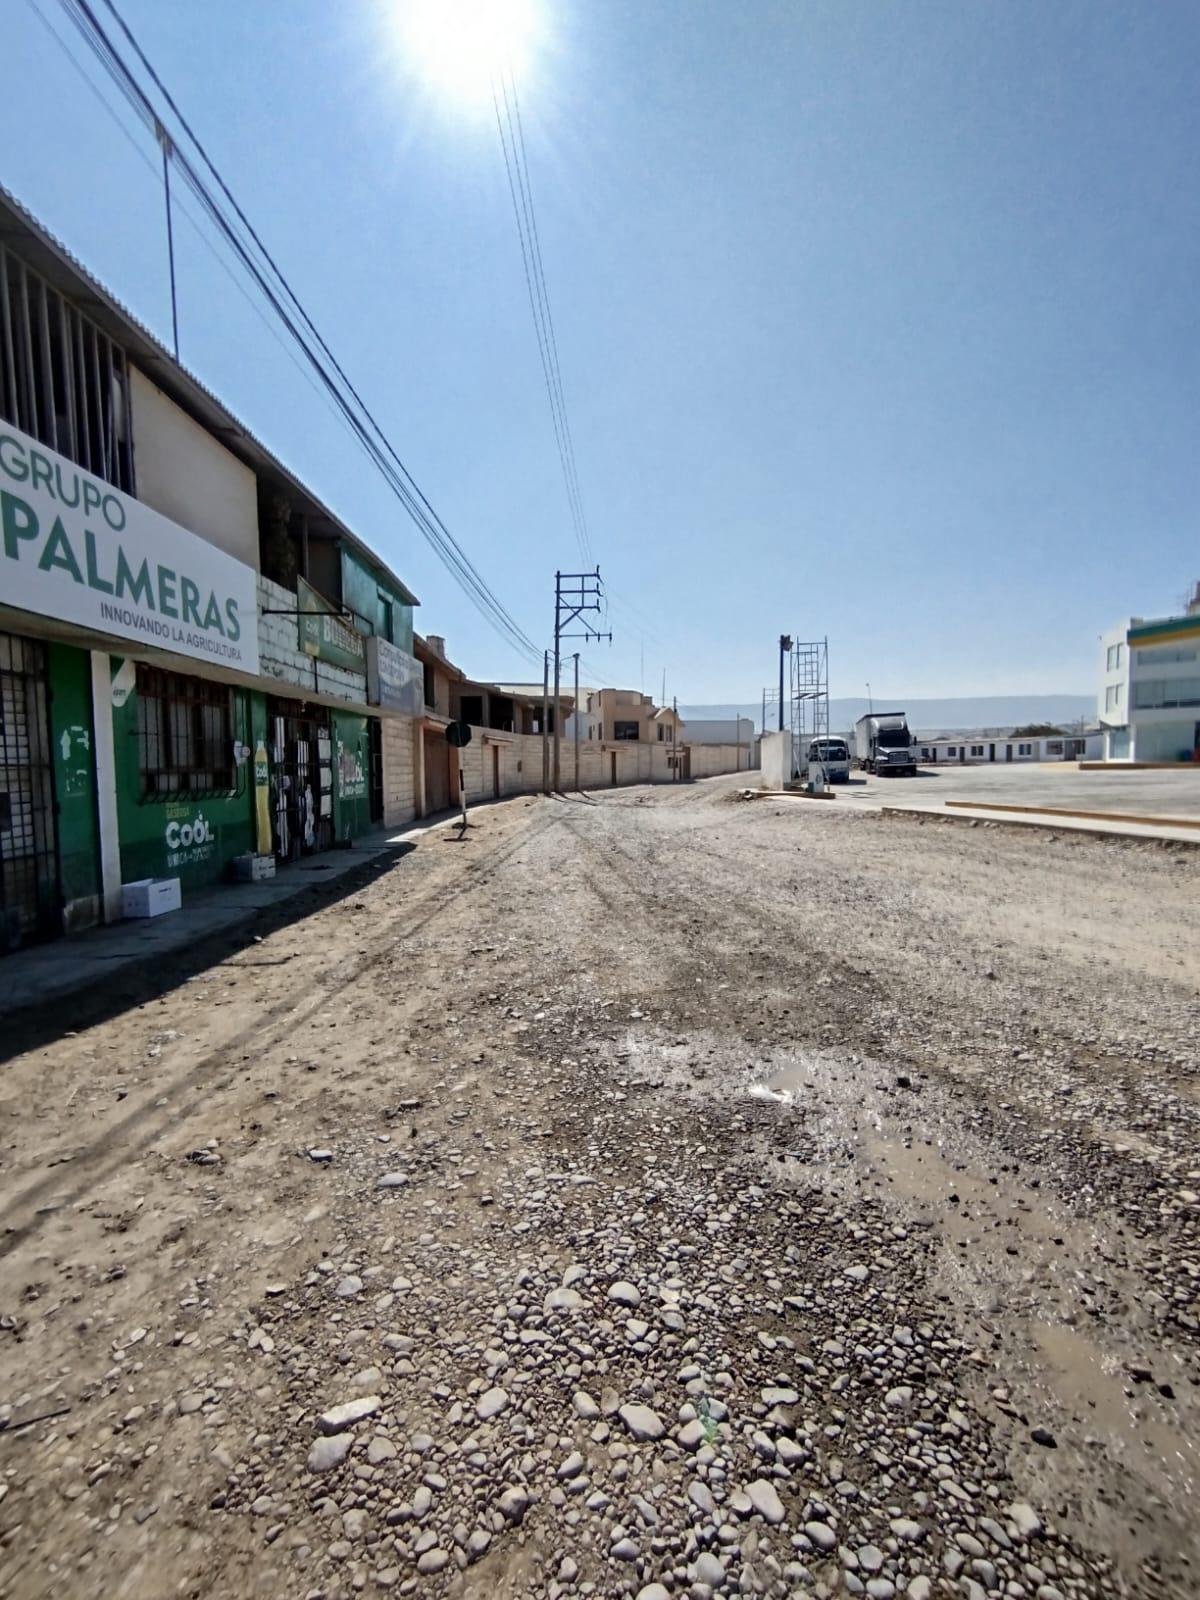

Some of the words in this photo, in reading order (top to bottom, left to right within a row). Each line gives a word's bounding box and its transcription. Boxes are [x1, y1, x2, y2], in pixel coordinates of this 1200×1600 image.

[0, 434, 126, 532] GRUPO
[0, 490, 241, 642] PALMERAS
[101, 602, 170, 638] INNOVANDO
[172, 629, 185, 643] LA
[186, 633, 242, 661] AGRICULTURA
